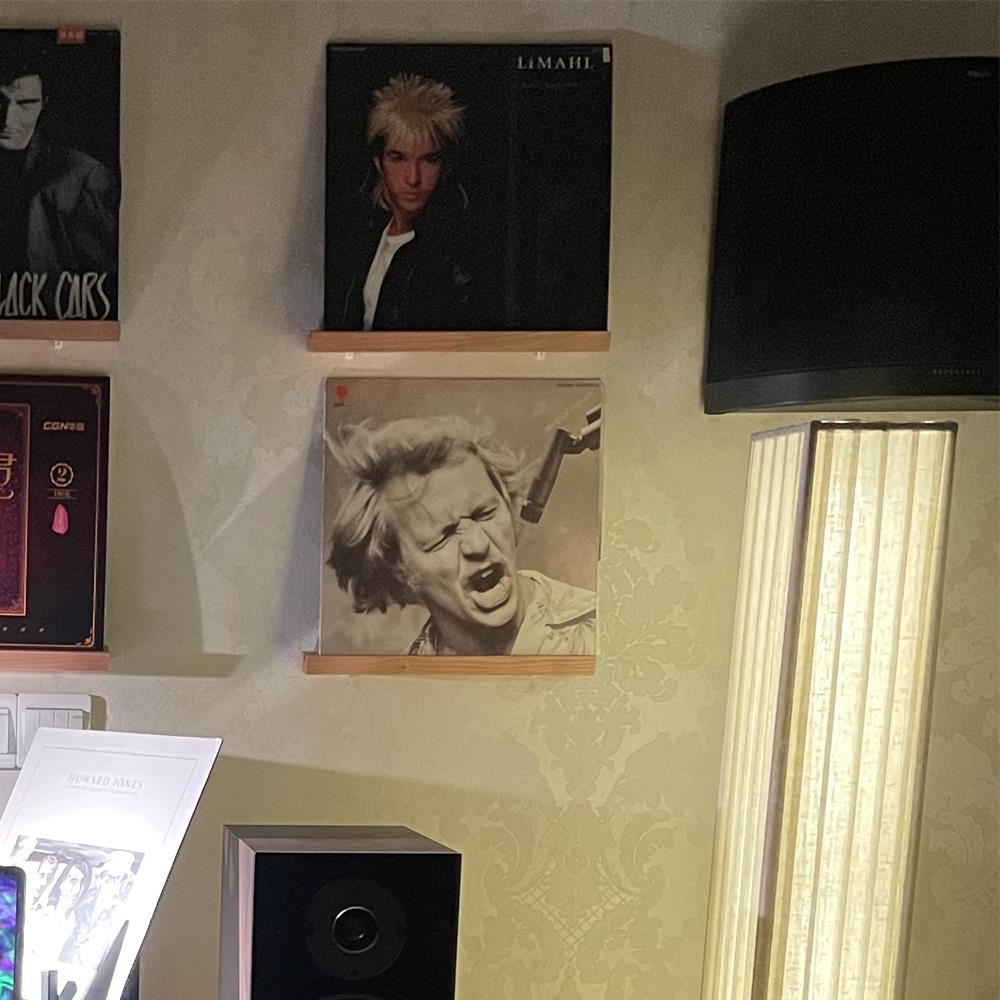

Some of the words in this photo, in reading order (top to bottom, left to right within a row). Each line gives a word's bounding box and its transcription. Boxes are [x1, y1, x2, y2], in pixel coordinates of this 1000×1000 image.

[54, 270, 111, 320] CARS
[56, 466, 68, 483] 2
[68, 772, 110, 786] HOWARD
[111, 776, 144, 790] JONES
